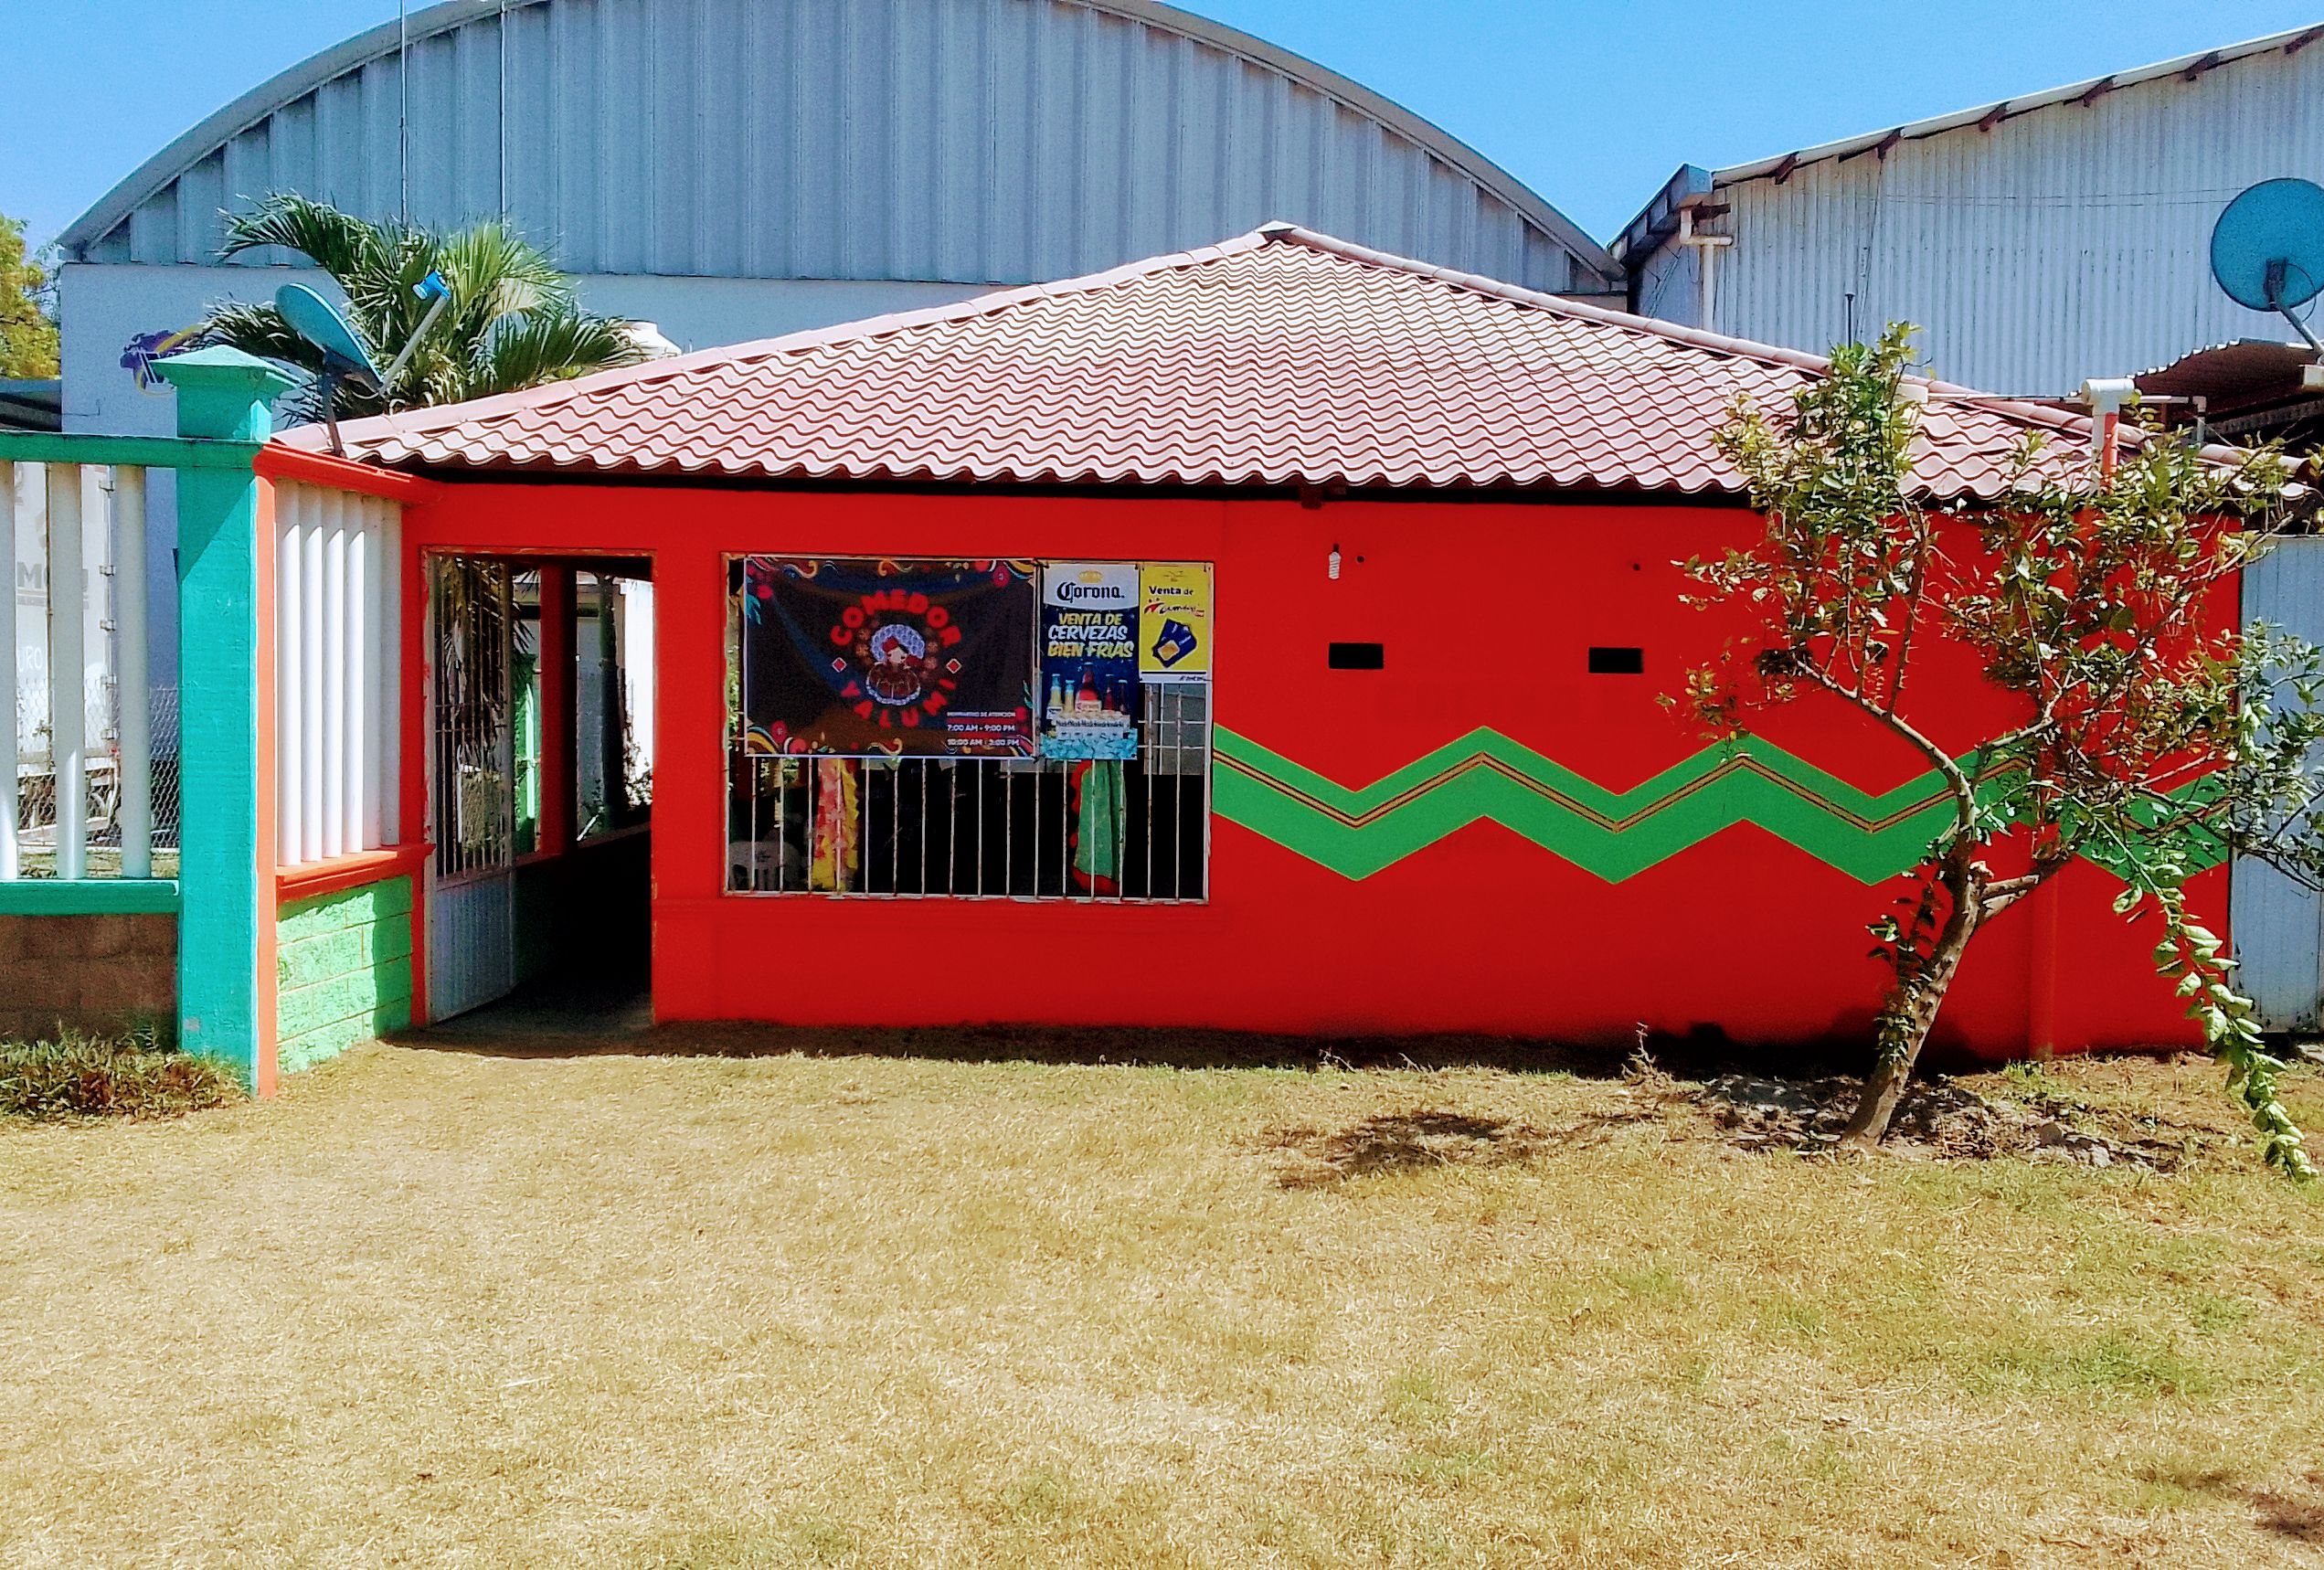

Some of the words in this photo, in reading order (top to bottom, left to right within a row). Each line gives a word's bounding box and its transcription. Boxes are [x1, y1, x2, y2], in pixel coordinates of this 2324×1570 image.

[1149, 586, 1182, 595] Venta
[830, 589, 961, 646] COMEDOR
[1059, 613, 1102, 625] VENTA
[1103, 613, 1122, 625] DE
[1048, 625, 1128, 640] CERVEZAS
[1047, 642, 1085, 657] BIEN
[1087, 641, 1134, 657] FRIAS
